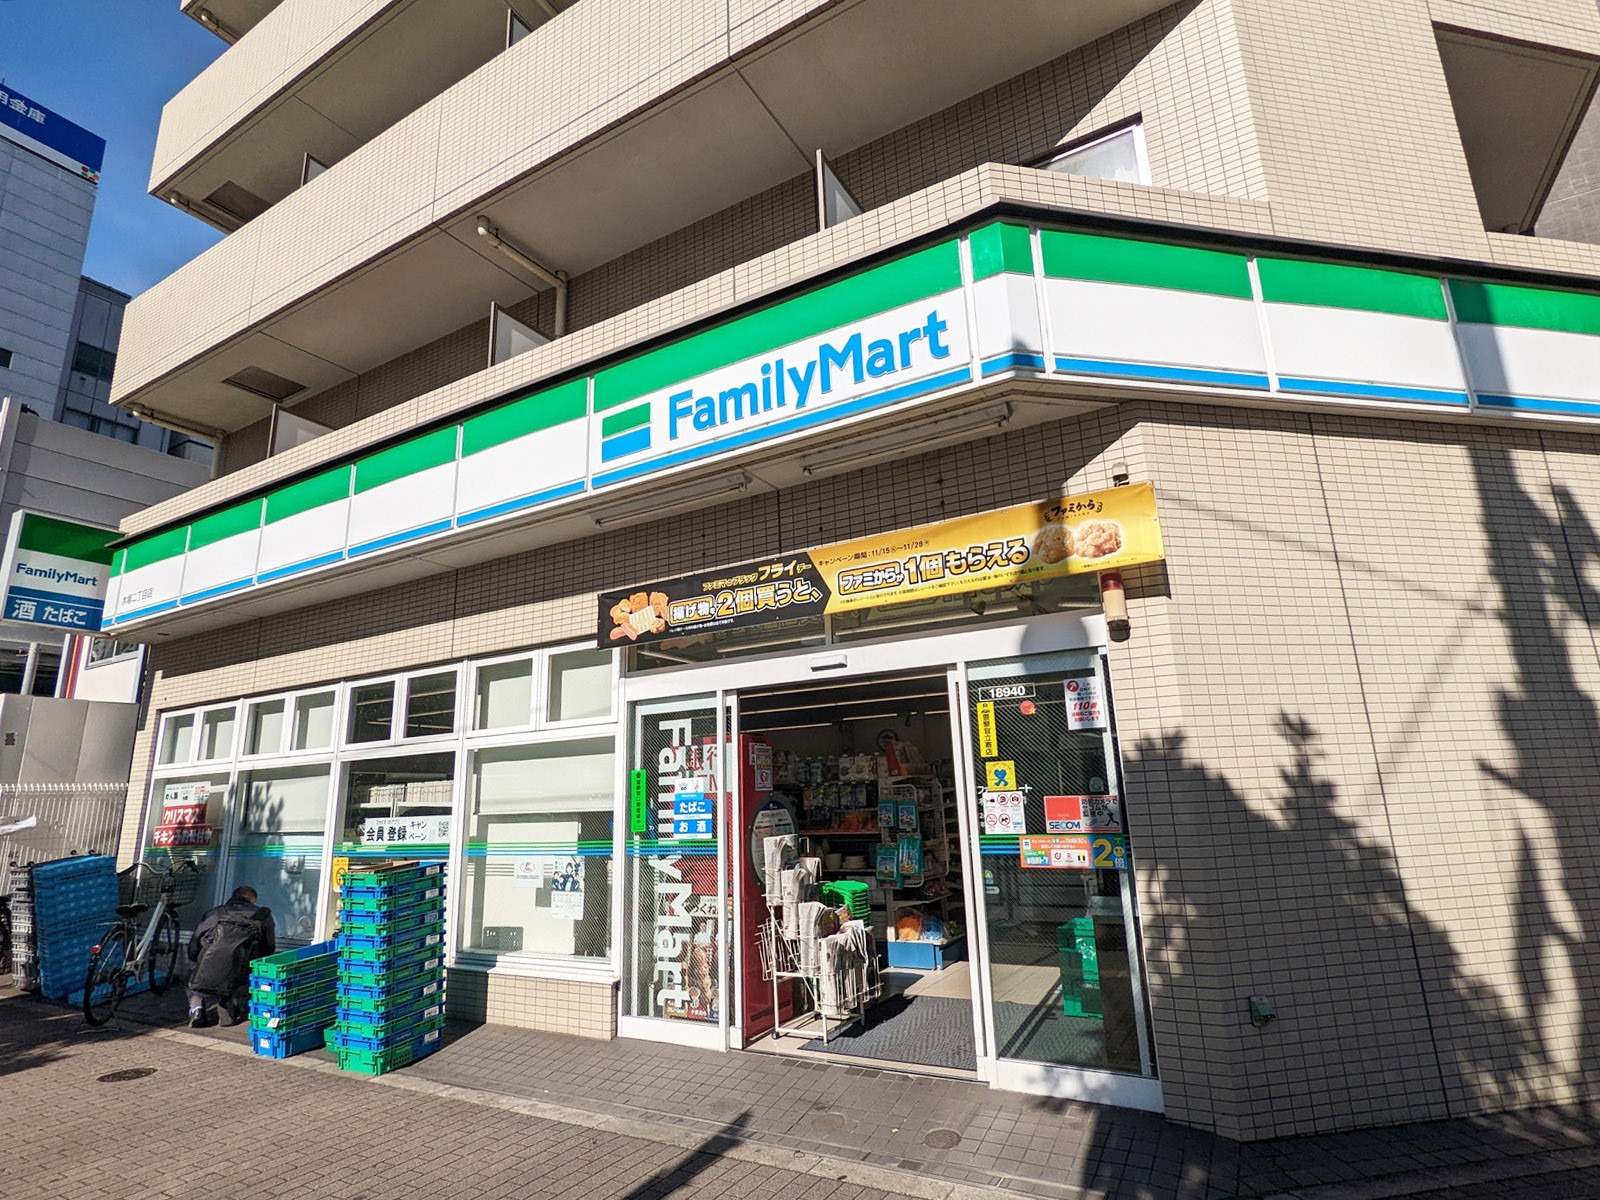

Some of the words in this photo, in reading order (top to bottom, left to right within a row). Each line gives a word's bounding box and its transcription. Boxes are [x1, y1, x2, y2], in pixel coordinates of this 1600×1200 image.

[669, 310, 950, 440] FamilyMart
[1051, 499, 1096, 516] ファミから
[16, 562, 98, 587] FamilyMart
[12, 600, 37, 620] 酒
[42, 606, 88, 625] たばこ
[989, 686, 1026, 698] 18940
[163, 807, 200, 824] クリスマス
[680, 801, 706, 814] たばこ
[366, 825, 407, 842] 会員登録
[1049, 821, 1081, 829] SECOM
[1092, 838, 1114, 867] 2
